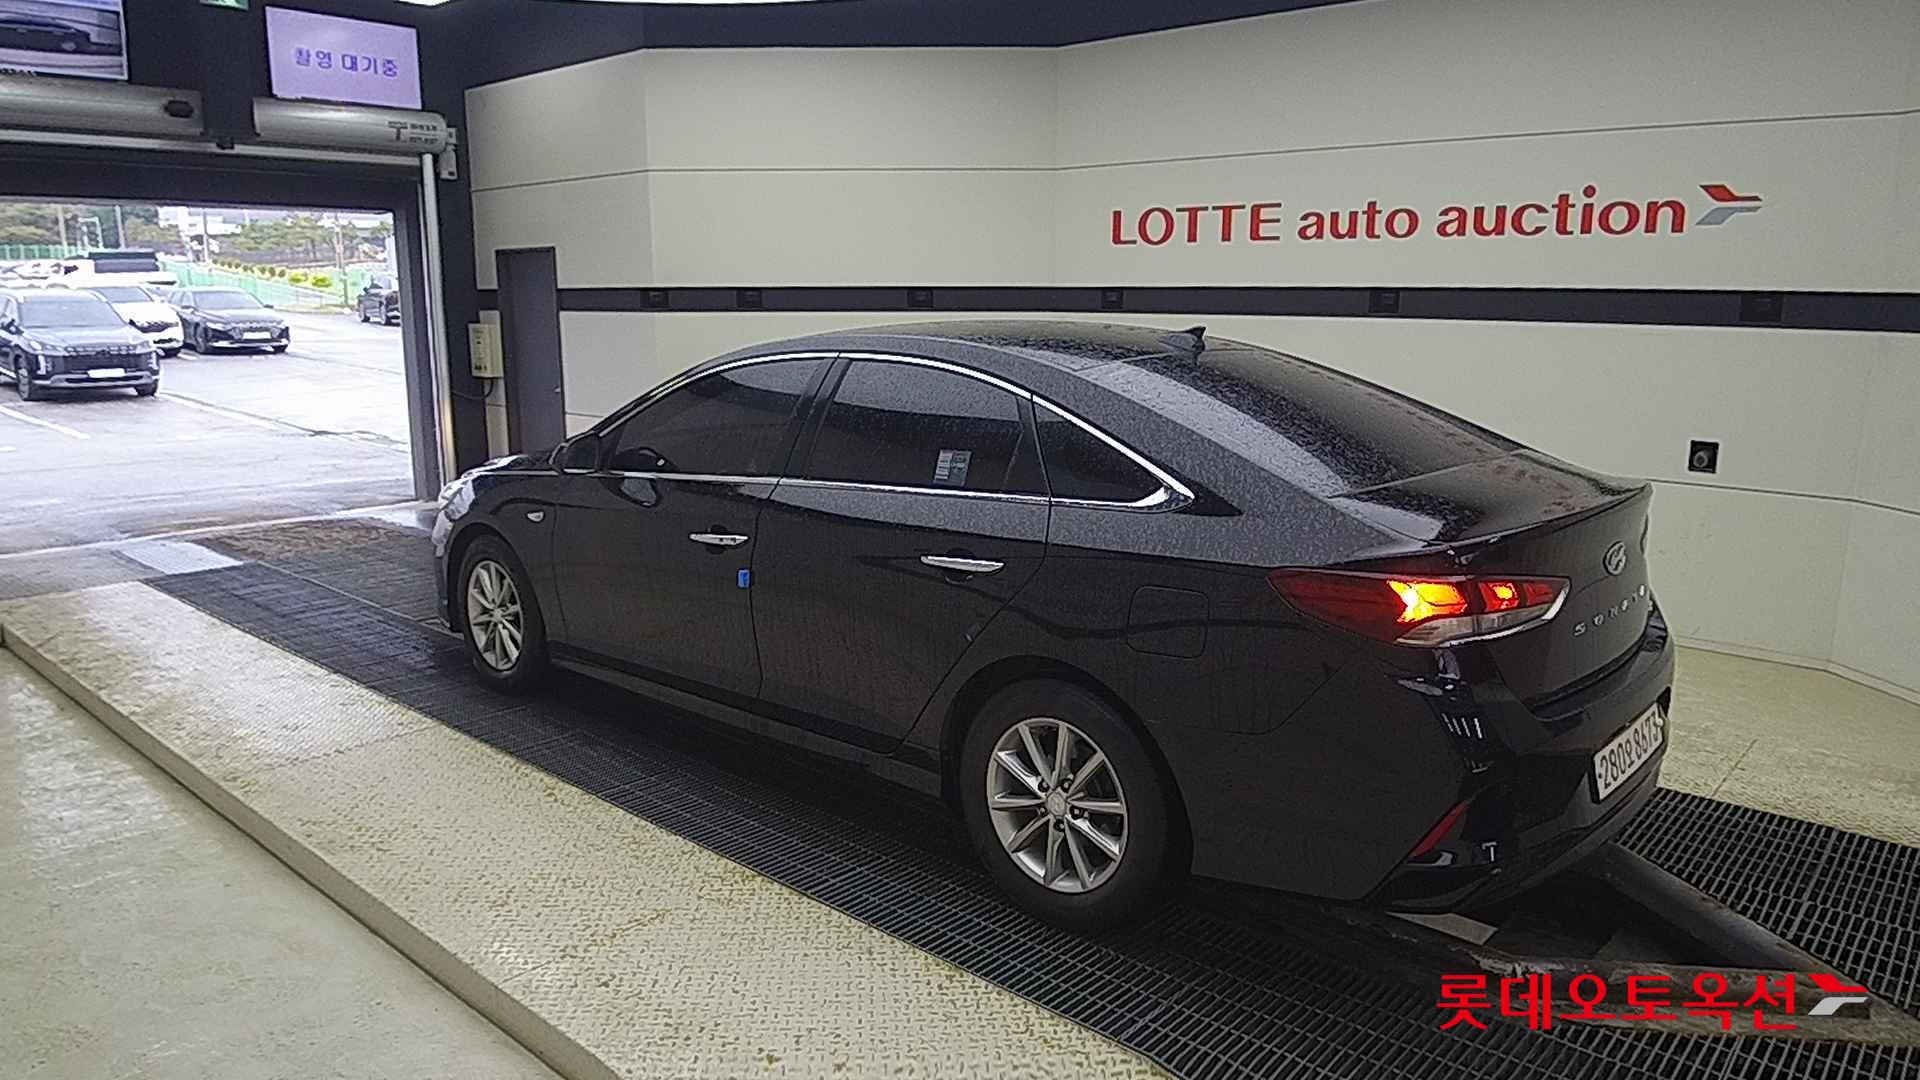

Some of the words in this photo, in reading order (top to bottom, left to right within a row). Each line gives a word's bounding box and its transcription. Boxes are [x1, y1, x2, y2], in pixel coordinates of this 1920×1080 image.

[341, 53, 399, 77] 대기중
[1111, 203, 1282, 245] LOTTE
[1297, 202, 1420, 240] auto
[1437, 184, 1686, 238] auction
